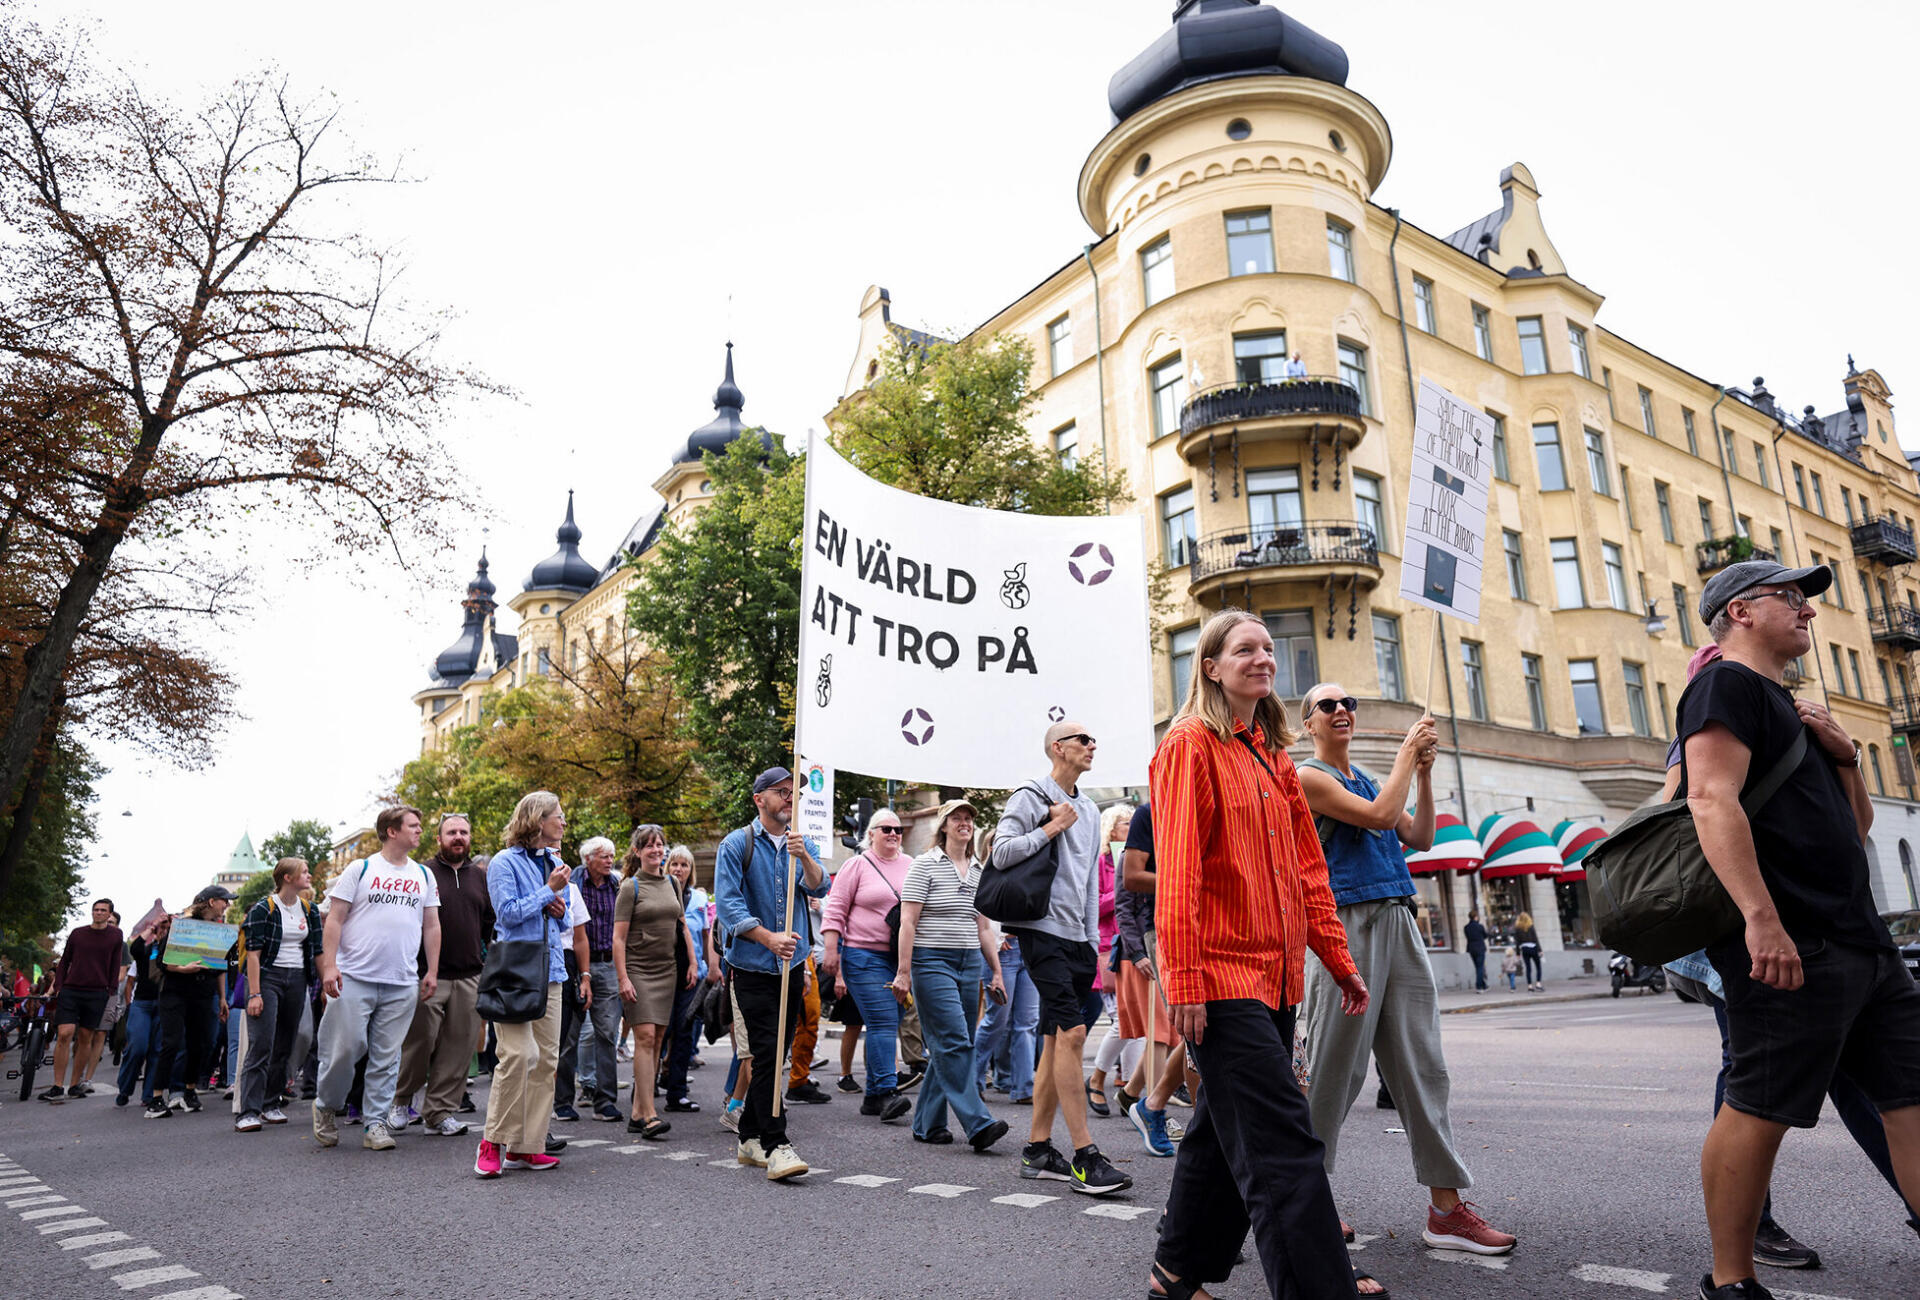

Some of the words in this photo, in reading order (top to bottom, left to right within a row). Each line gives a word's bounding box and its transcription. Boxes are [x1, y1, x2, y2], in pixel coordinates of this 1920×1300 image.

[1462, 410, 1476, 436] THE
[1427, 433, 1437, 456] OF
[1439, 436, 1453, 464] THE
[1455, 449, 1479, 480] WORLD
[1430, 483, 1457, 523] LOOK
[1422, 507, 1435, 534] AT
[1436, 514, 1450, 543] THE
[1454, 523, 1475, 555] BIRDS
[815, 509, 848, 568] EN
[856, 537, 976, 604] VÄRLD
[812, 585, 862, 646] ATT
[873, 616, 960, 669] TRO
[978, 626, 1038, 674] PÅ
[370, 876, 421, 894] AGERA
